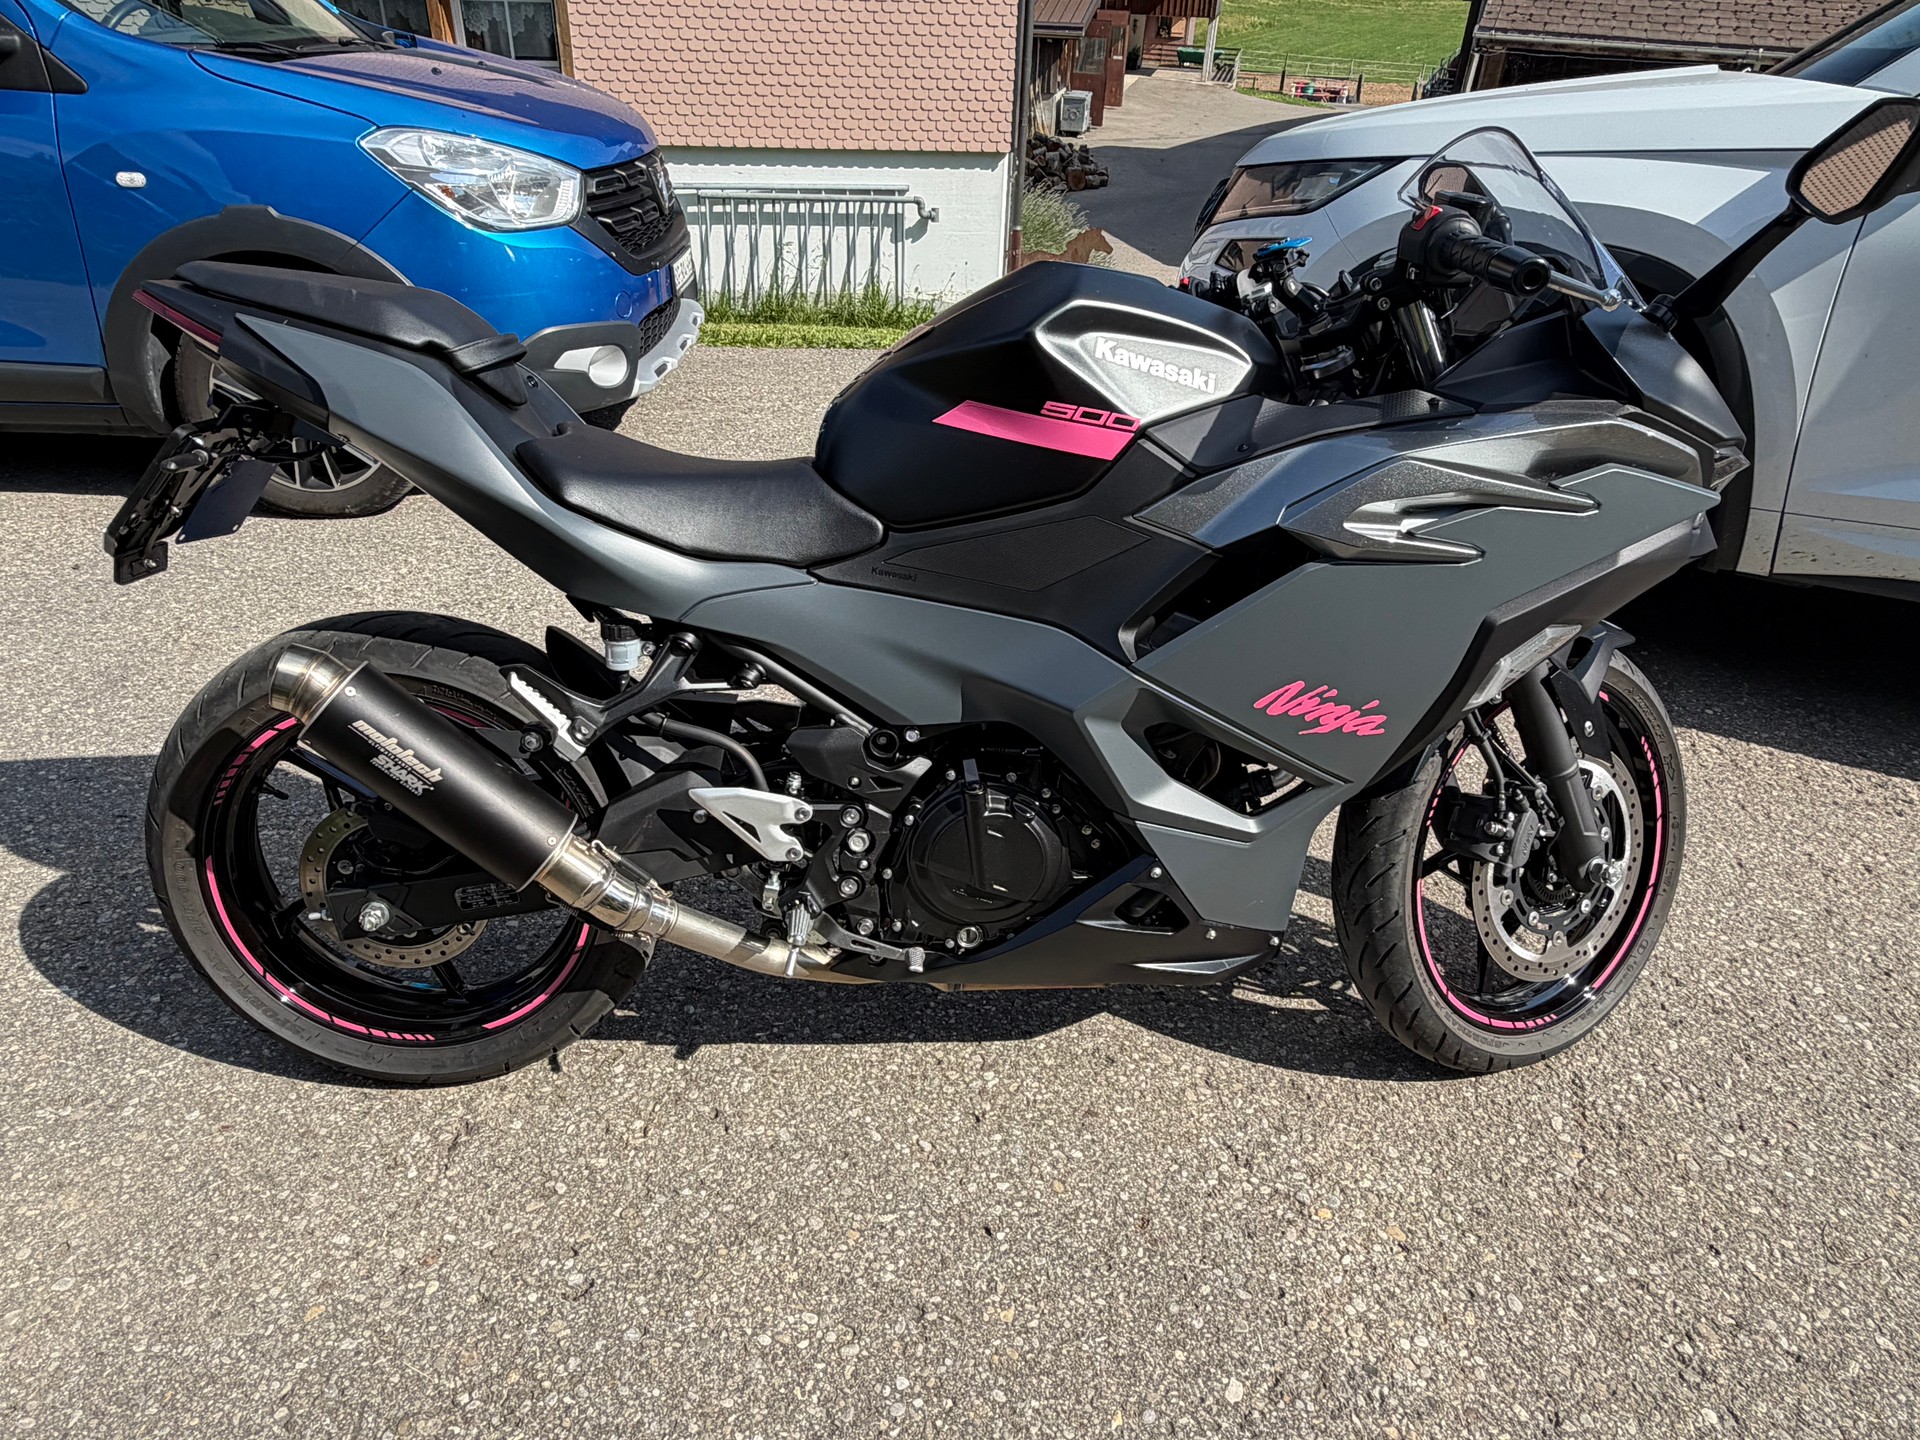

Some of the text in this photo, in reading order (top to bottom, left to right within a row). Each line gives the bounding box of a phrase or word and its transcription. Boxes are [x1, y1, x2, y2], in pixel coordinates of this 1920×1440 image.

[1095, 336, 1217, 395] Kawasaki
[1040, 400, 1141, 432] 500
[871, 566, 917, 582] Kawasaki
[1253, 680, 1387, 736] Ninja
[352, 719, 444, 783] mototech
[374, 754, 434, 794] SHARK
